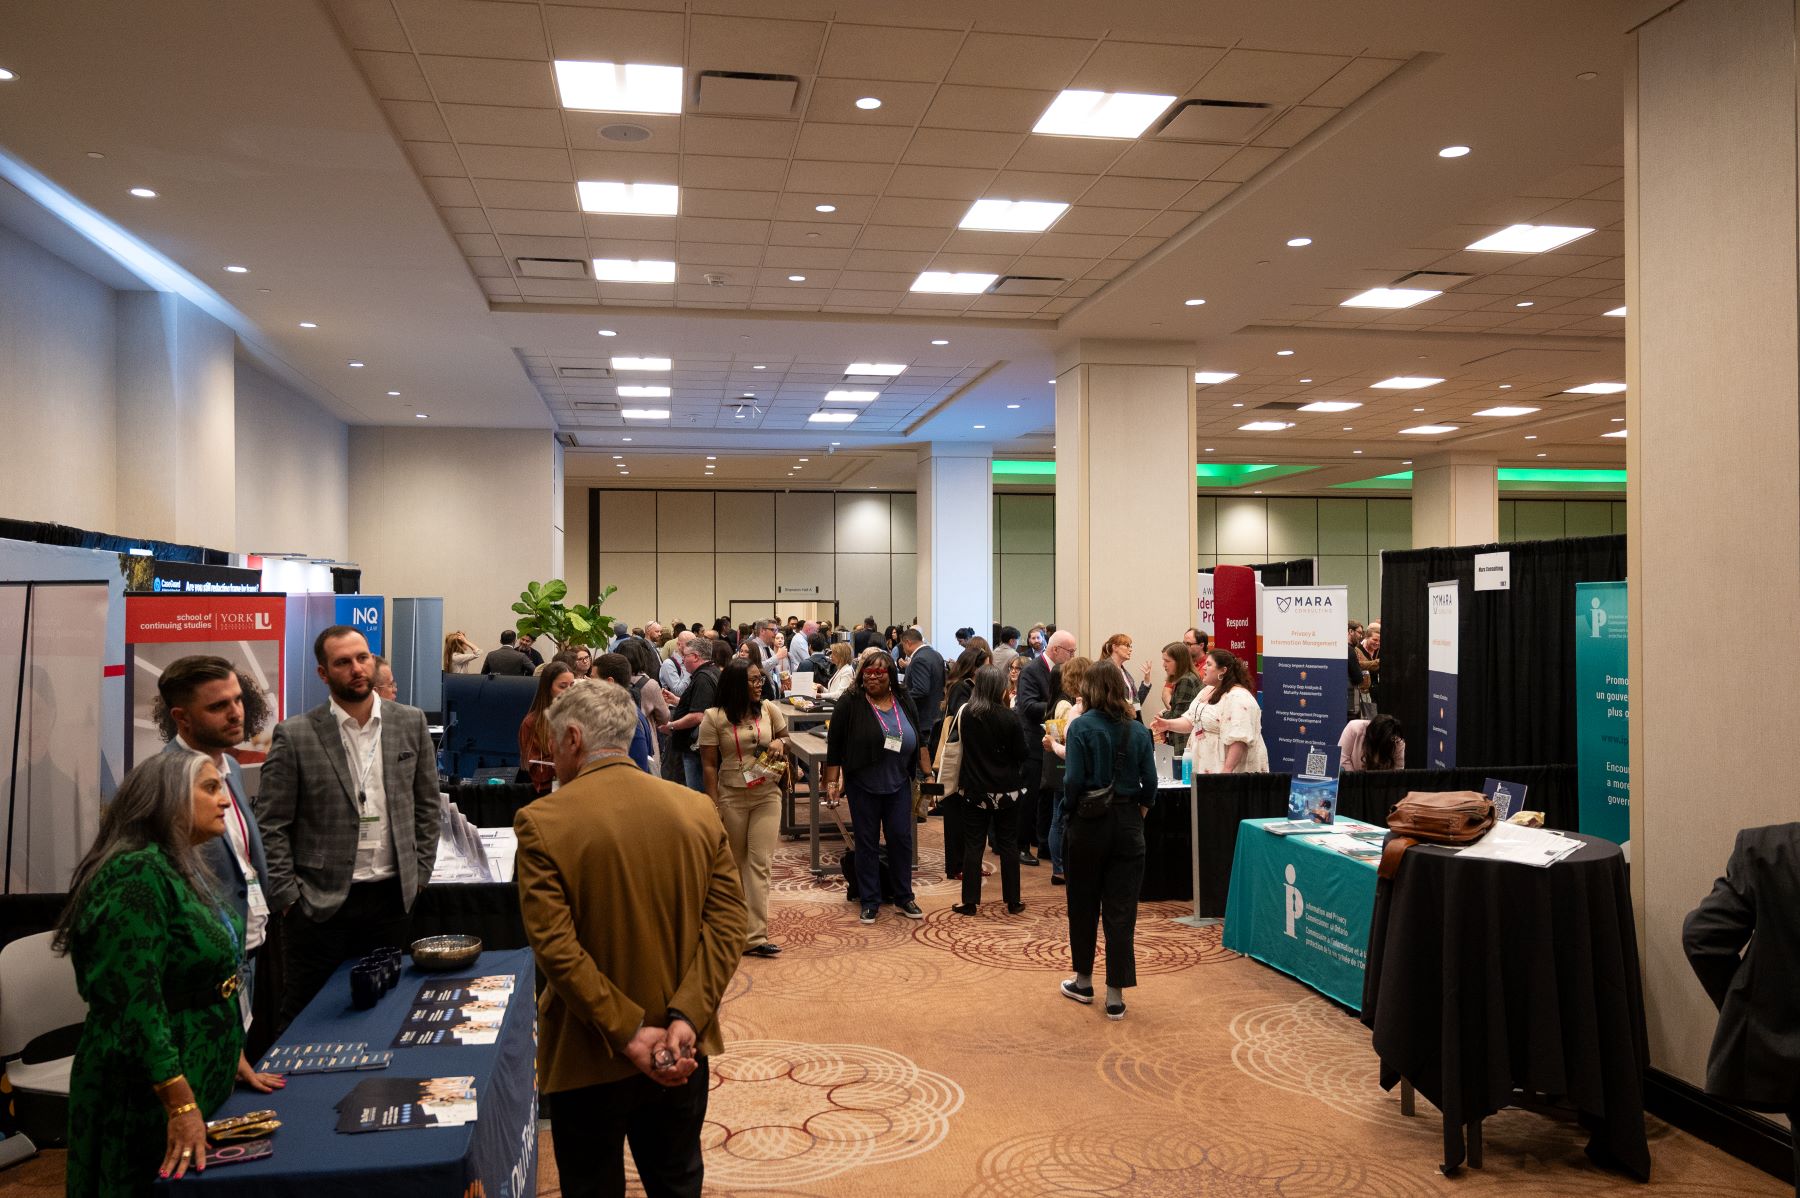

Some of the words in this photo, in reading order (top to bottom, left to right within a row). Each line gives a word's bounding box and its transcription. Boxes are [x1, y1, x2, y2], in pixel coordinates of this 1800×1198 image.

[186, 580, 194, 592] Are
[1295, 596, 1332, 606] MARA
[221, 614, 254, 622] YORK
[353, 607, 378, 624] INQ
[140, 622, 182, 630] continuing
[1226, 618, 1248, 629] Respond
[1230, 640, 1245, 650] React
[1596, 691, 1604, 699] un
[1608, 706, 1622, 718] plus
[1333, 912, 1347, 926] Privacy
